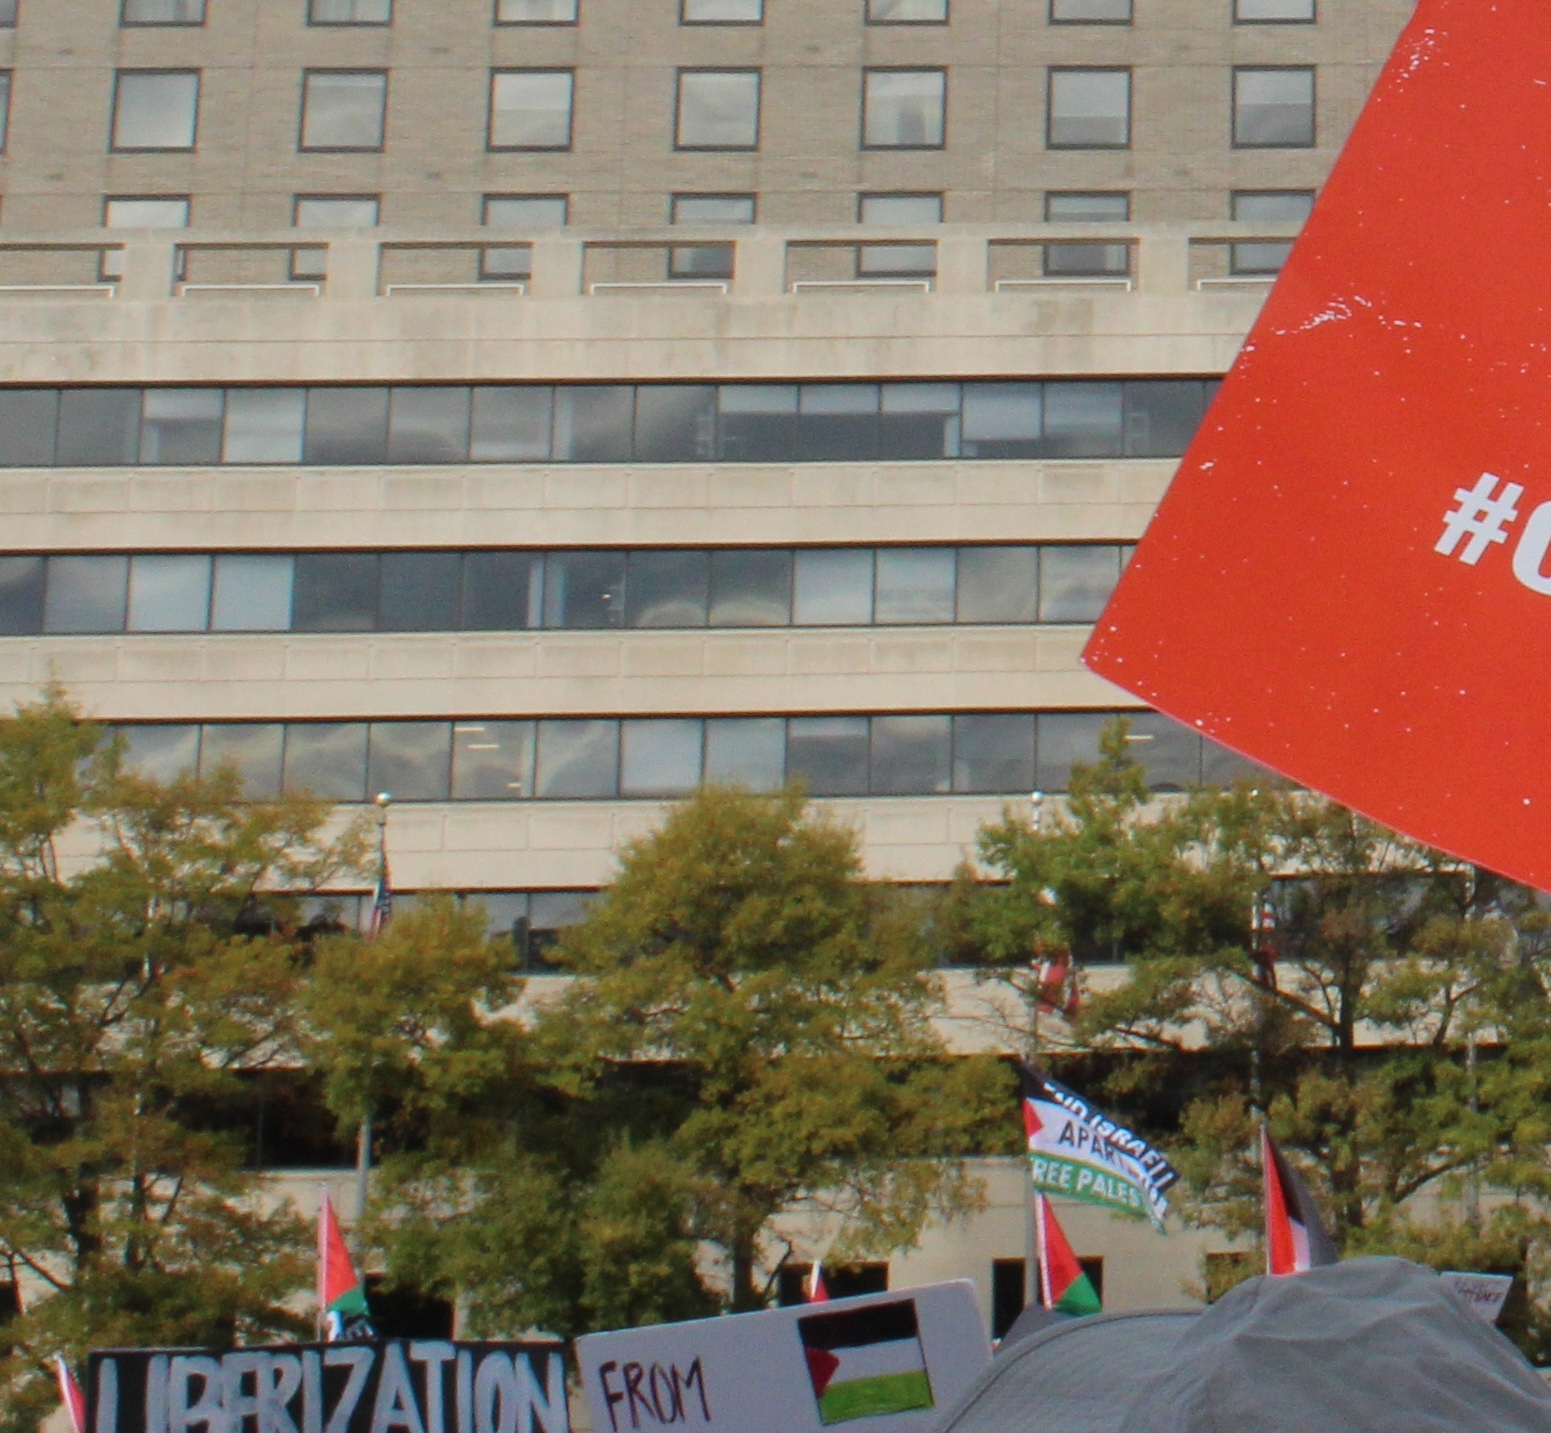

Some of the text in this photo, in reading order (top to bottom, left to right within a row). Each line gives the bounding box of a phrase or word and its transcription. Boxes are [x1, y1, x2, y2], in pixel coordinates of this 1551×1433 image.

[1031, 1156, 1142, 1208] REE PALES
[599, 1354, 713, 1433] FROM
